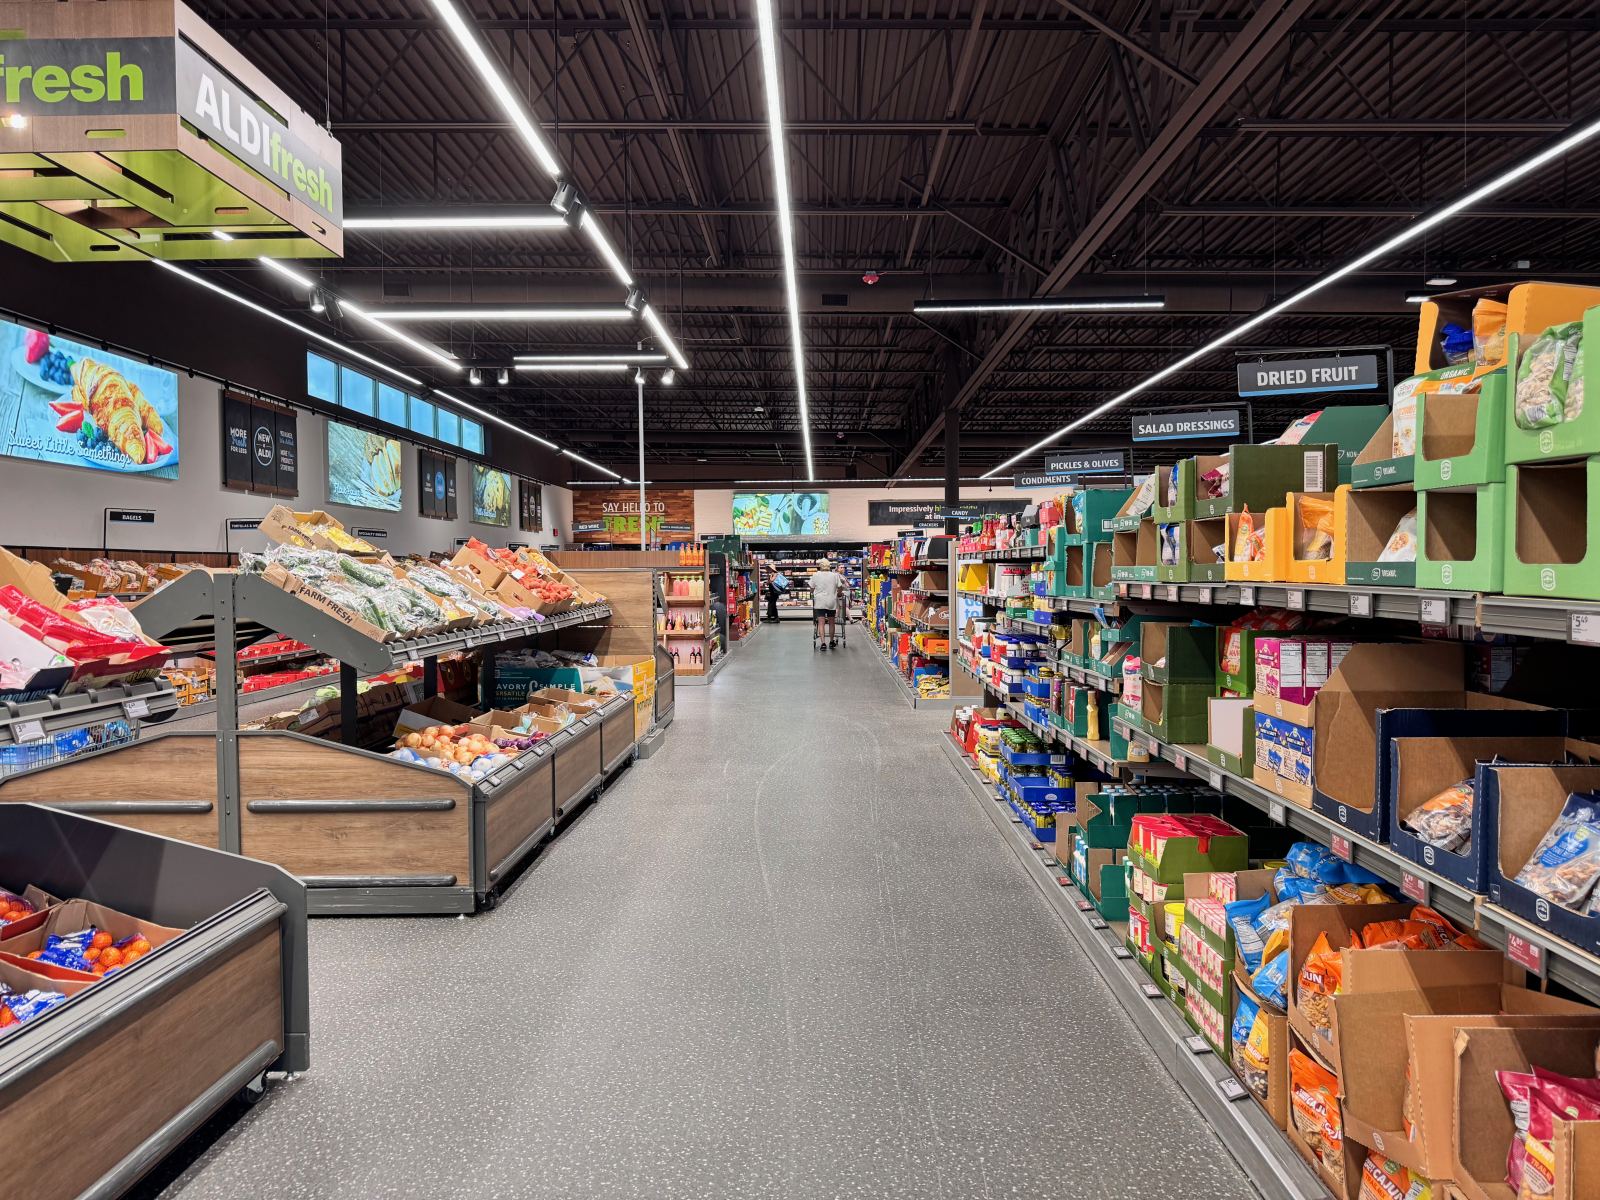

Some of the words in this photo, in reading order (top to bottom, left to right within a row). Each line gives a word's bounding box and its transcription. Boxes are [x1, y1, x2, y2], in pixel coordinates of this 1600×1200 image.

[1257, 369, 1307, 387] DRIED
[1311, 366, 1359, 383] FRUIT
[1440, 367, 1471, 380] ORGANIC
[230, 427, 247, 438] MORE
[1138, 423, 1174, 435] SALAD
[1176, 419, 1235, 432] DRESSINGS
[258, 432, 271, 443] NEW
[8, 428, 43, 450] Sweet
[45, 436, 76, 456] Little
[77, 440, 131, 468] Somethings
[258, 448, 271, 459] ALDI
[1050, 461, 1082, 470] PICKLES
[1091, 459, 1119, 468] OLIVES
[1021, 475, 1071, 485] CONDIMENTS
[602, 502, 620, 513] SAY
[622, 502, 650, 513] HELO
[653, 502, 665, 513] TO
[889, 505, 934, 515] Impressively
[299, 586, 327, 604] FARM
[326, 600, 354, 624] FRESH
[1364, 1174, 1378, 1190] TRAIL
[1376, 1187, 1387, 1199] MIX
[1372, 1169, 1406, 1200] CAJUN
